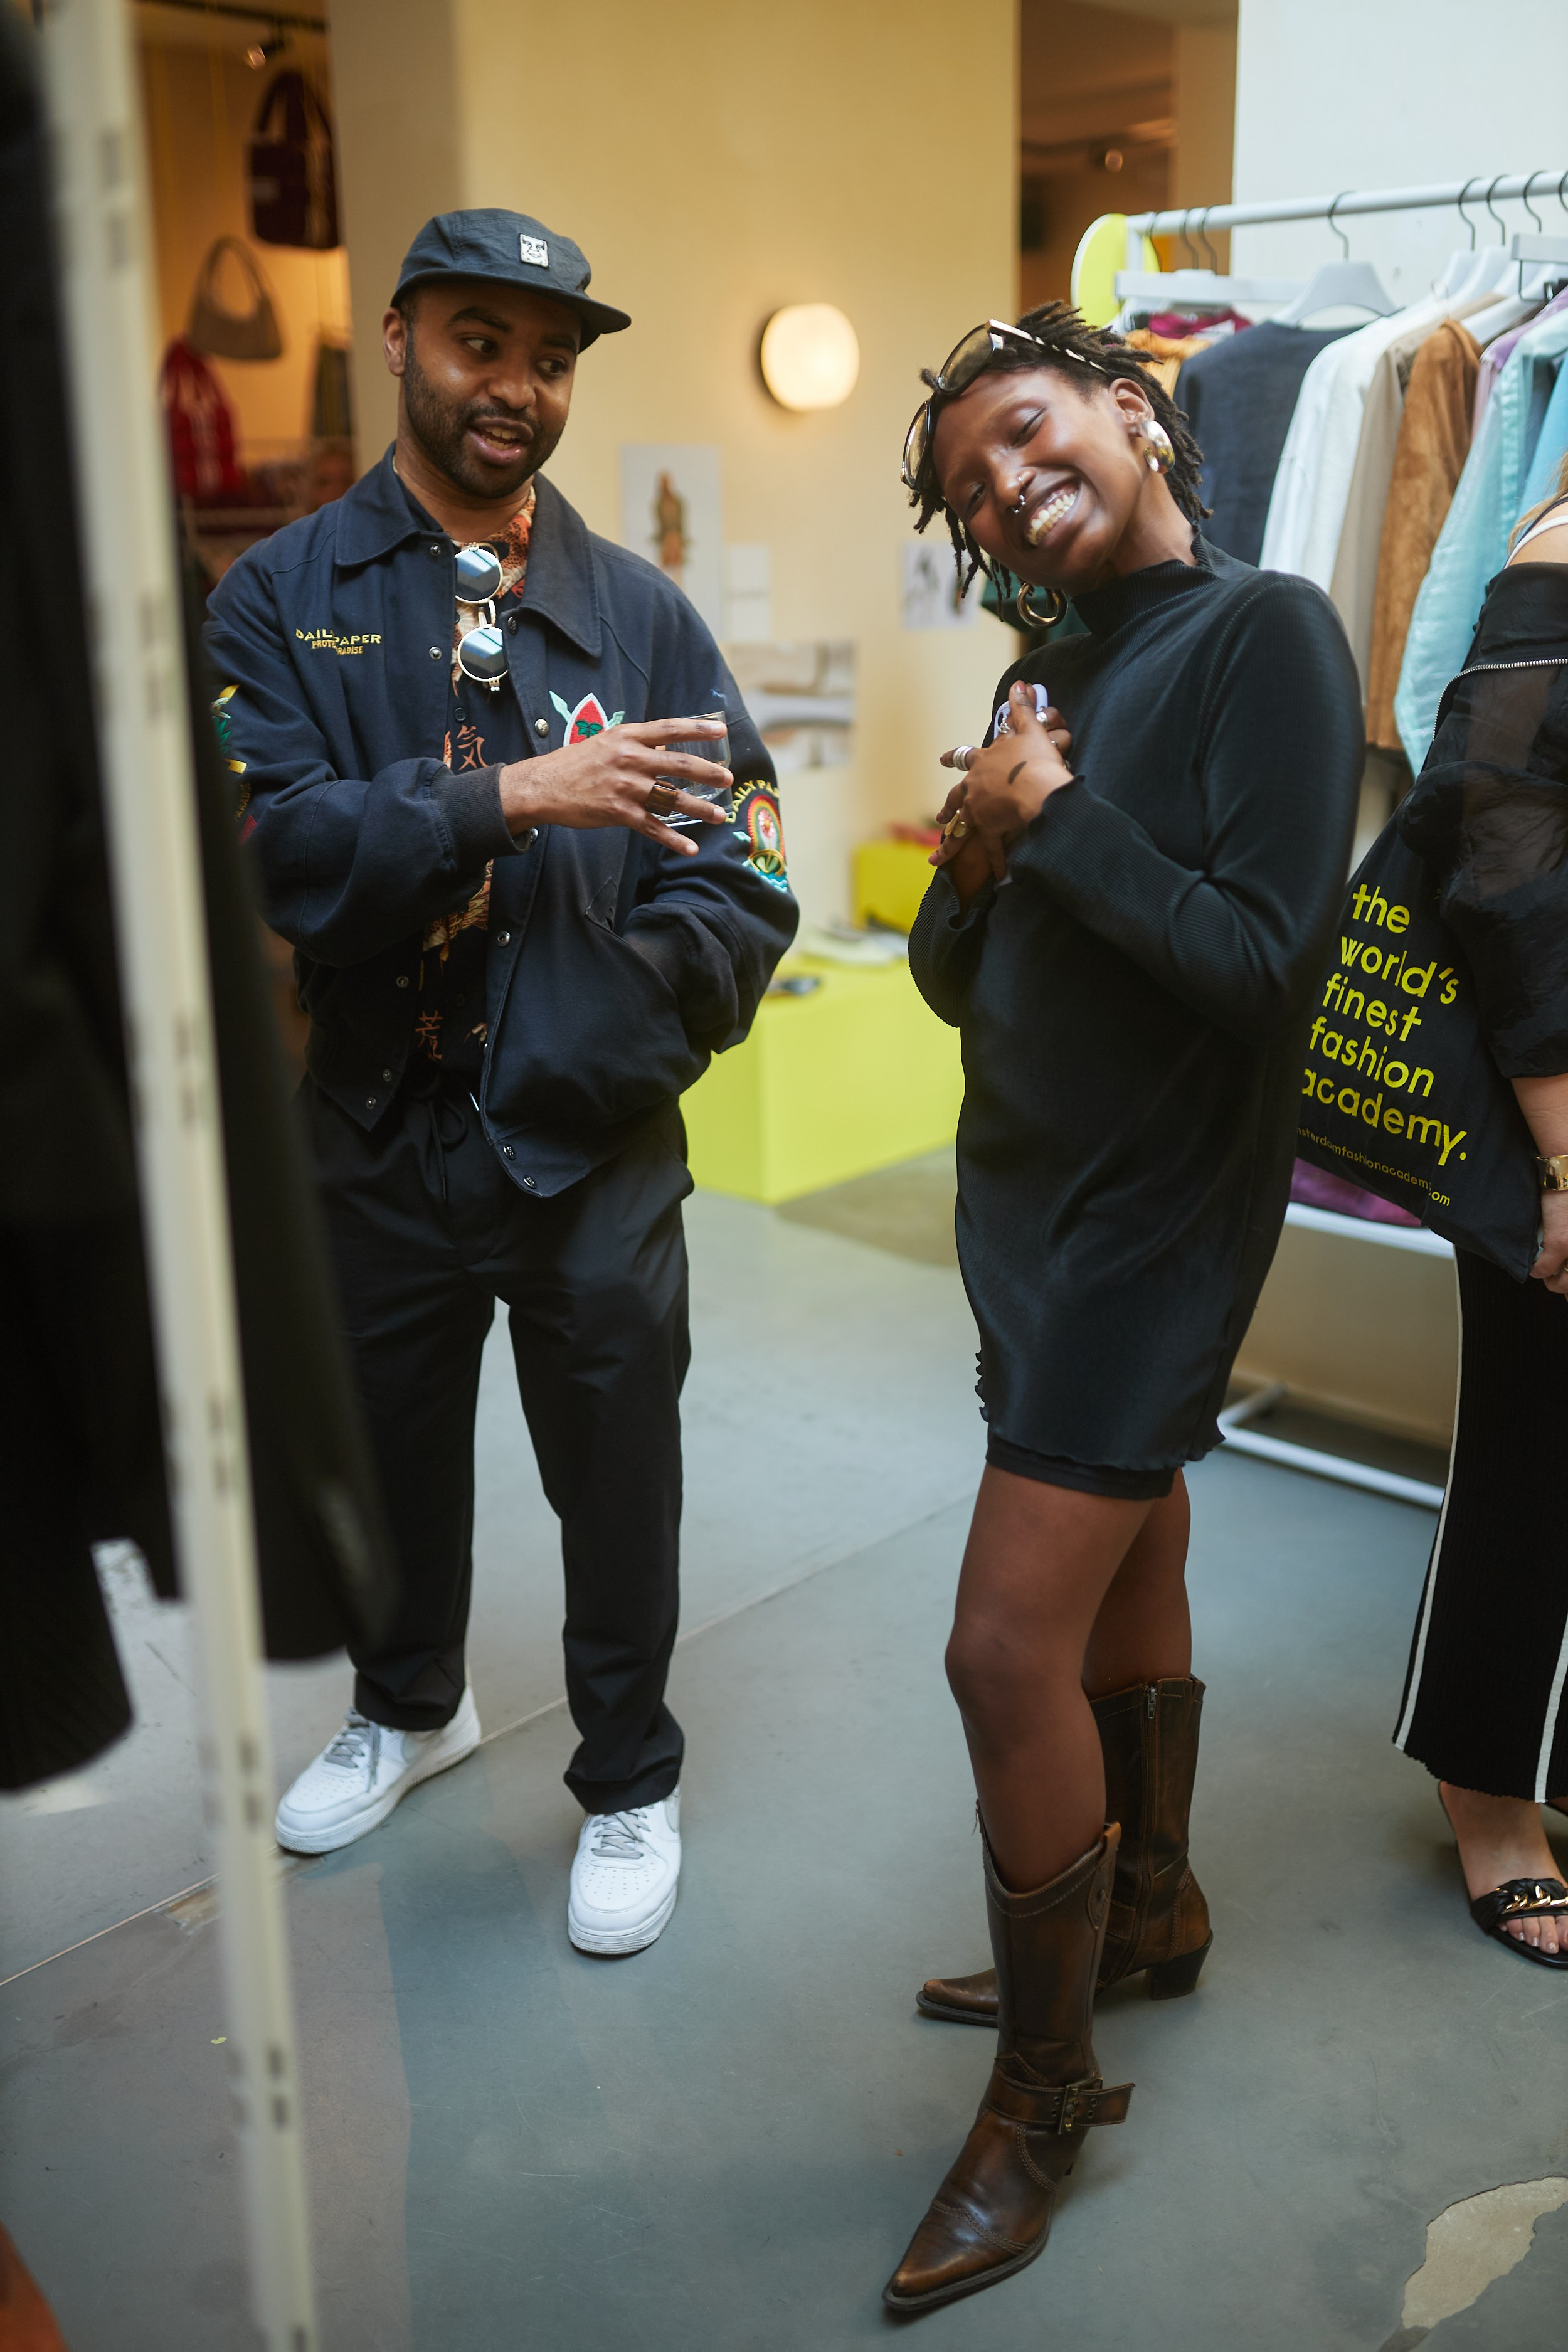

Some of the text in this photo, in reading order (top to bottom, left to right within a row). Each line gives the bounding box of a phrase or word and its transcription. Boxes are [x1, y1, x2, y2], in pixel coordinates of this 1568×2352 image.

[295, 628, 335, 641] DAIL
[724, 780, 756, 824] DAILY
[1352, 883, 1411, 933] the
[1341, 936, 1459, 1004] world's
[1322, 972, 1422, 1042] finest
[1309, 1015, 1435, 1097] fashion
[1301, 1068, 1468, 1167] academy.
